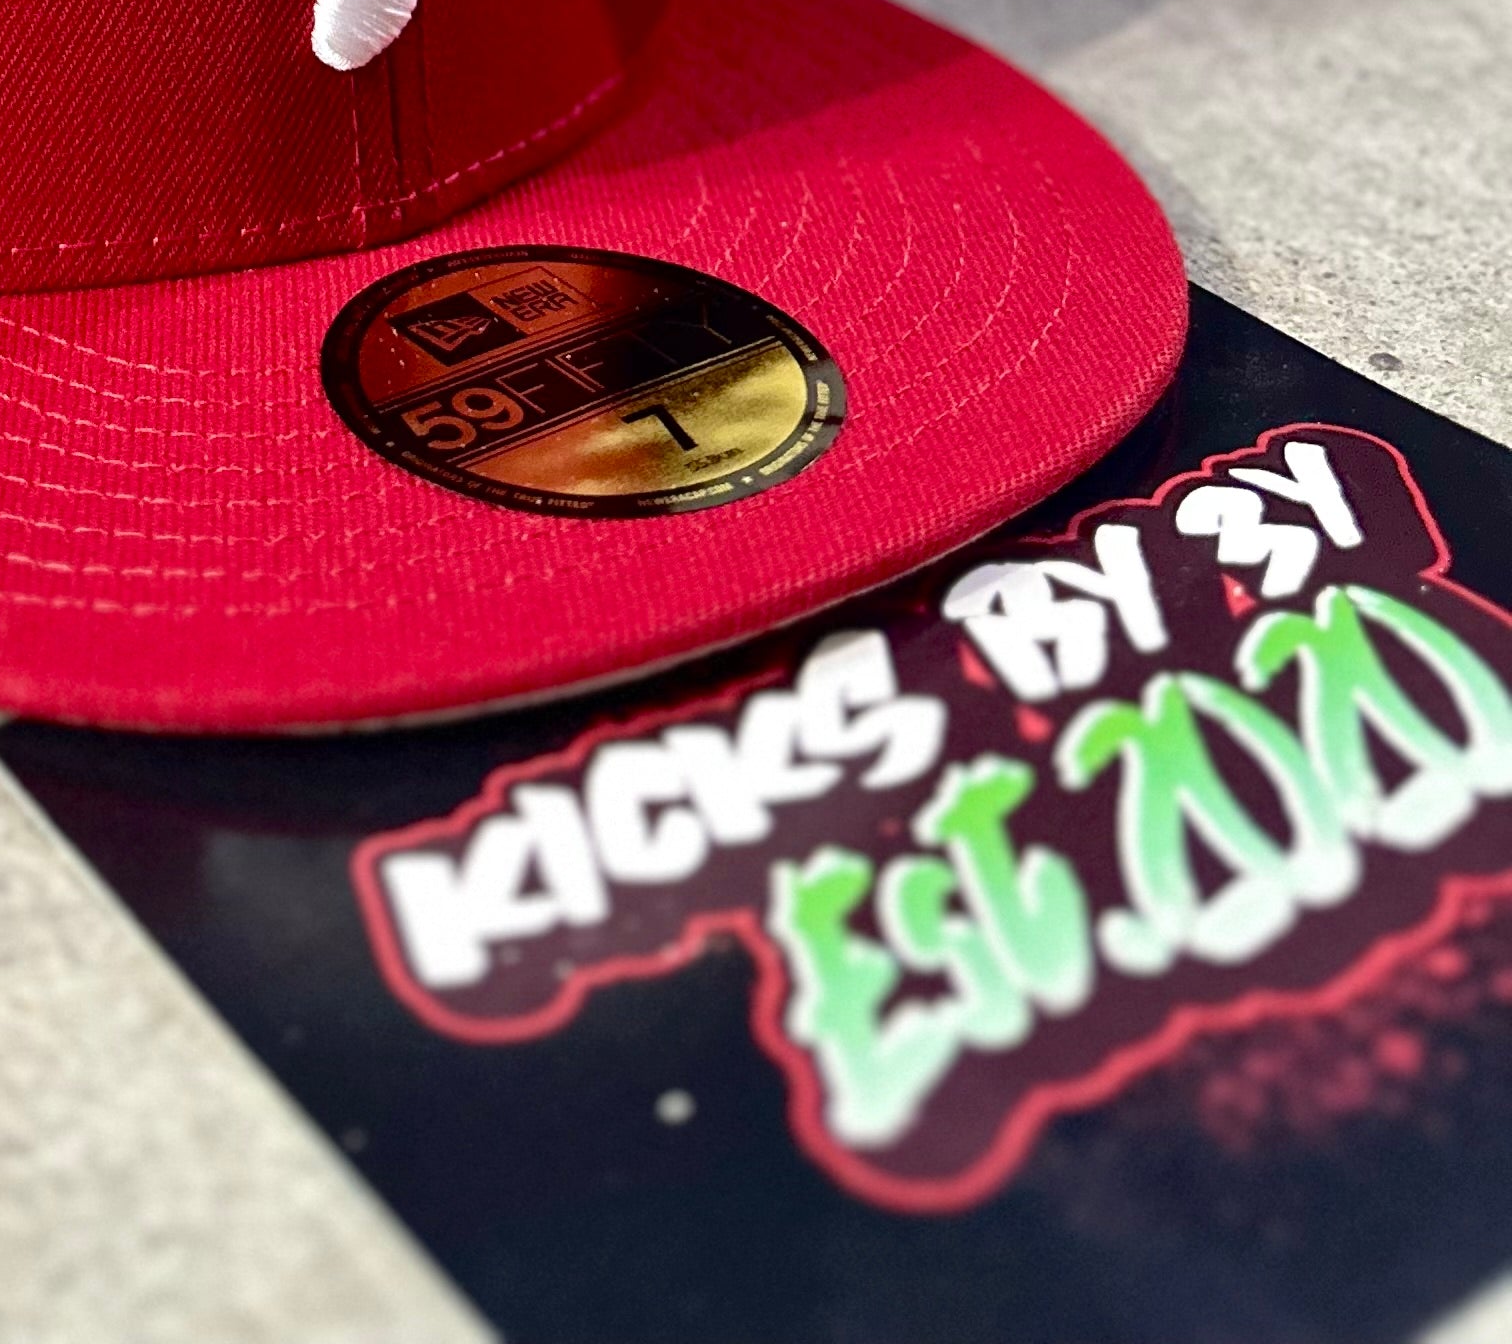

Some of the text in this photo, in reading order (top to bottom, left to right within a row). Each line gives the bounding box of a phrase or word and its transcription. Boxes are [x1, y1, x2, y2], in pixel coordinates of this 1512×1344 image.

[490, 278, 559, 310] NEW
[511, 291, 580, 322] ERA
[400, 300, 733, 450] 59FIFTY
[621, 404, 699, 452] 7
[381, 628, 947, 988] KICKS
[941, 524, 1170, 702] BY
